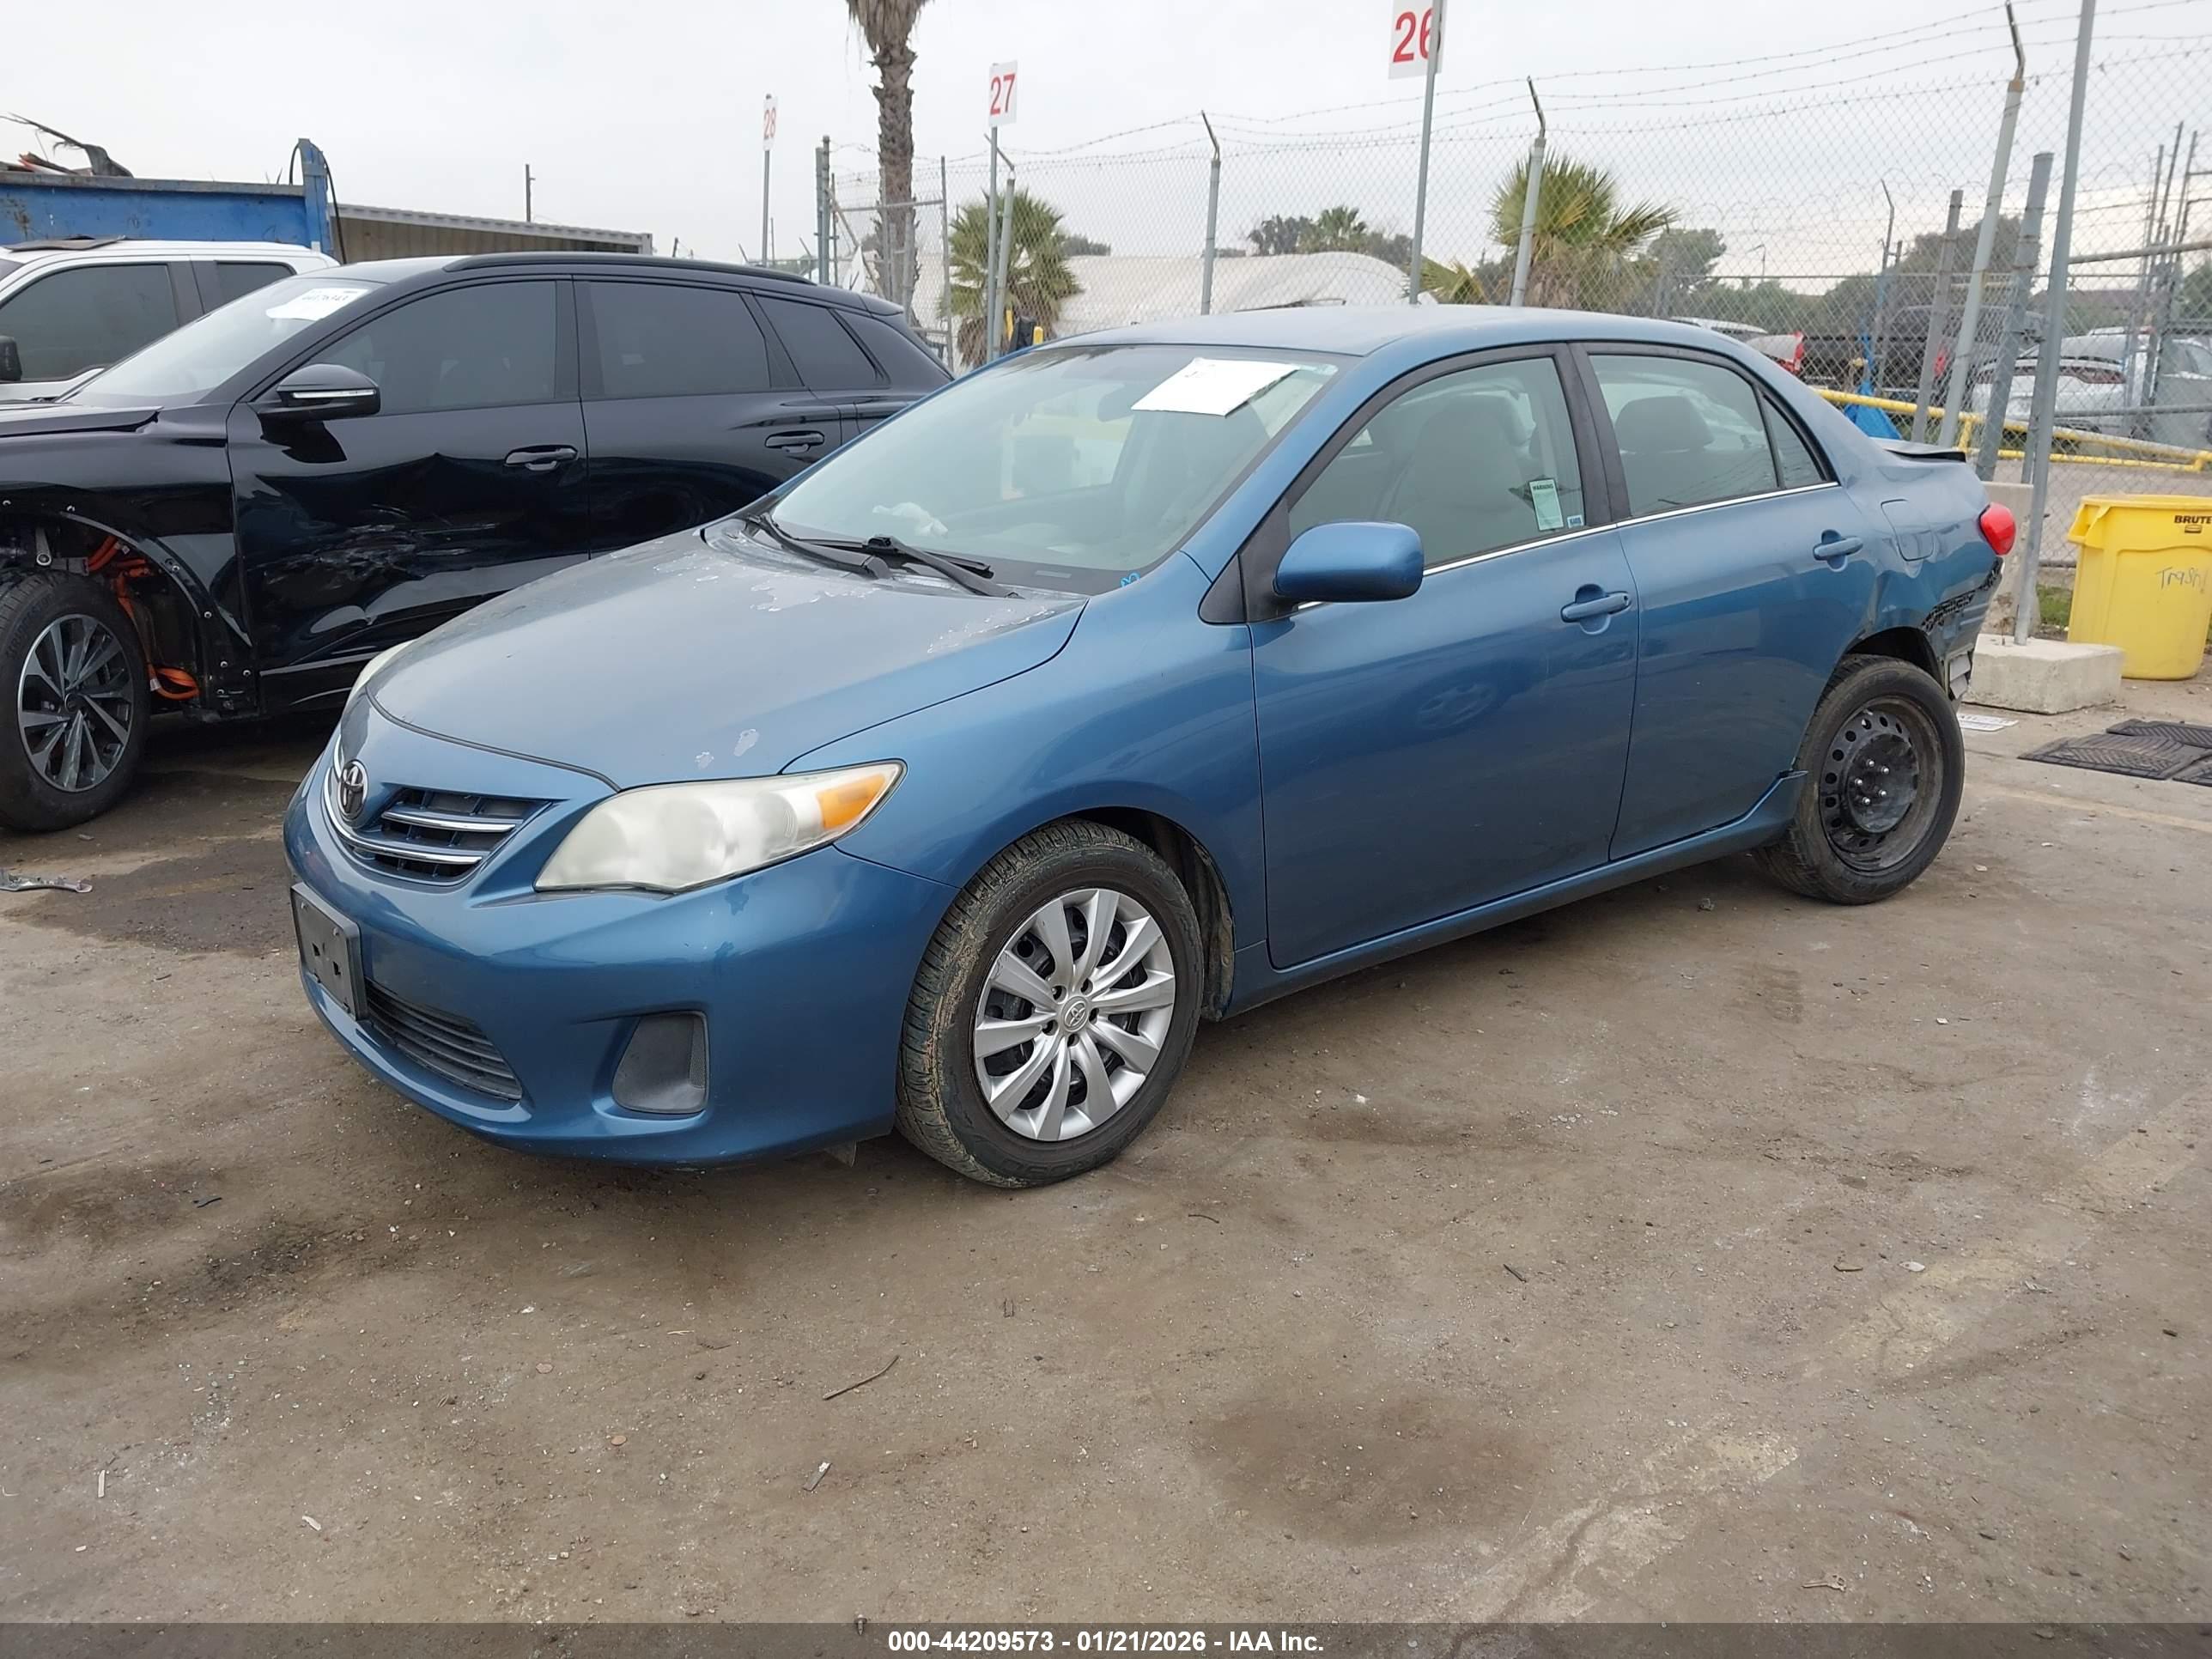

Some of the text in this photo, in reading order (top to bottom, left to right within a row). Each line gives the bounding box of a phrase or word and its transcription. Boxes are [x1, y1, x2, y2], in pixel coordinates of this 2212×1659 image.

[1393, 8, 1442, 63] 26
[990, 73, 1016, 116] 27
[763, 107, 777, 140] 28
[2174, 515, 2212, 524] BRUTE
